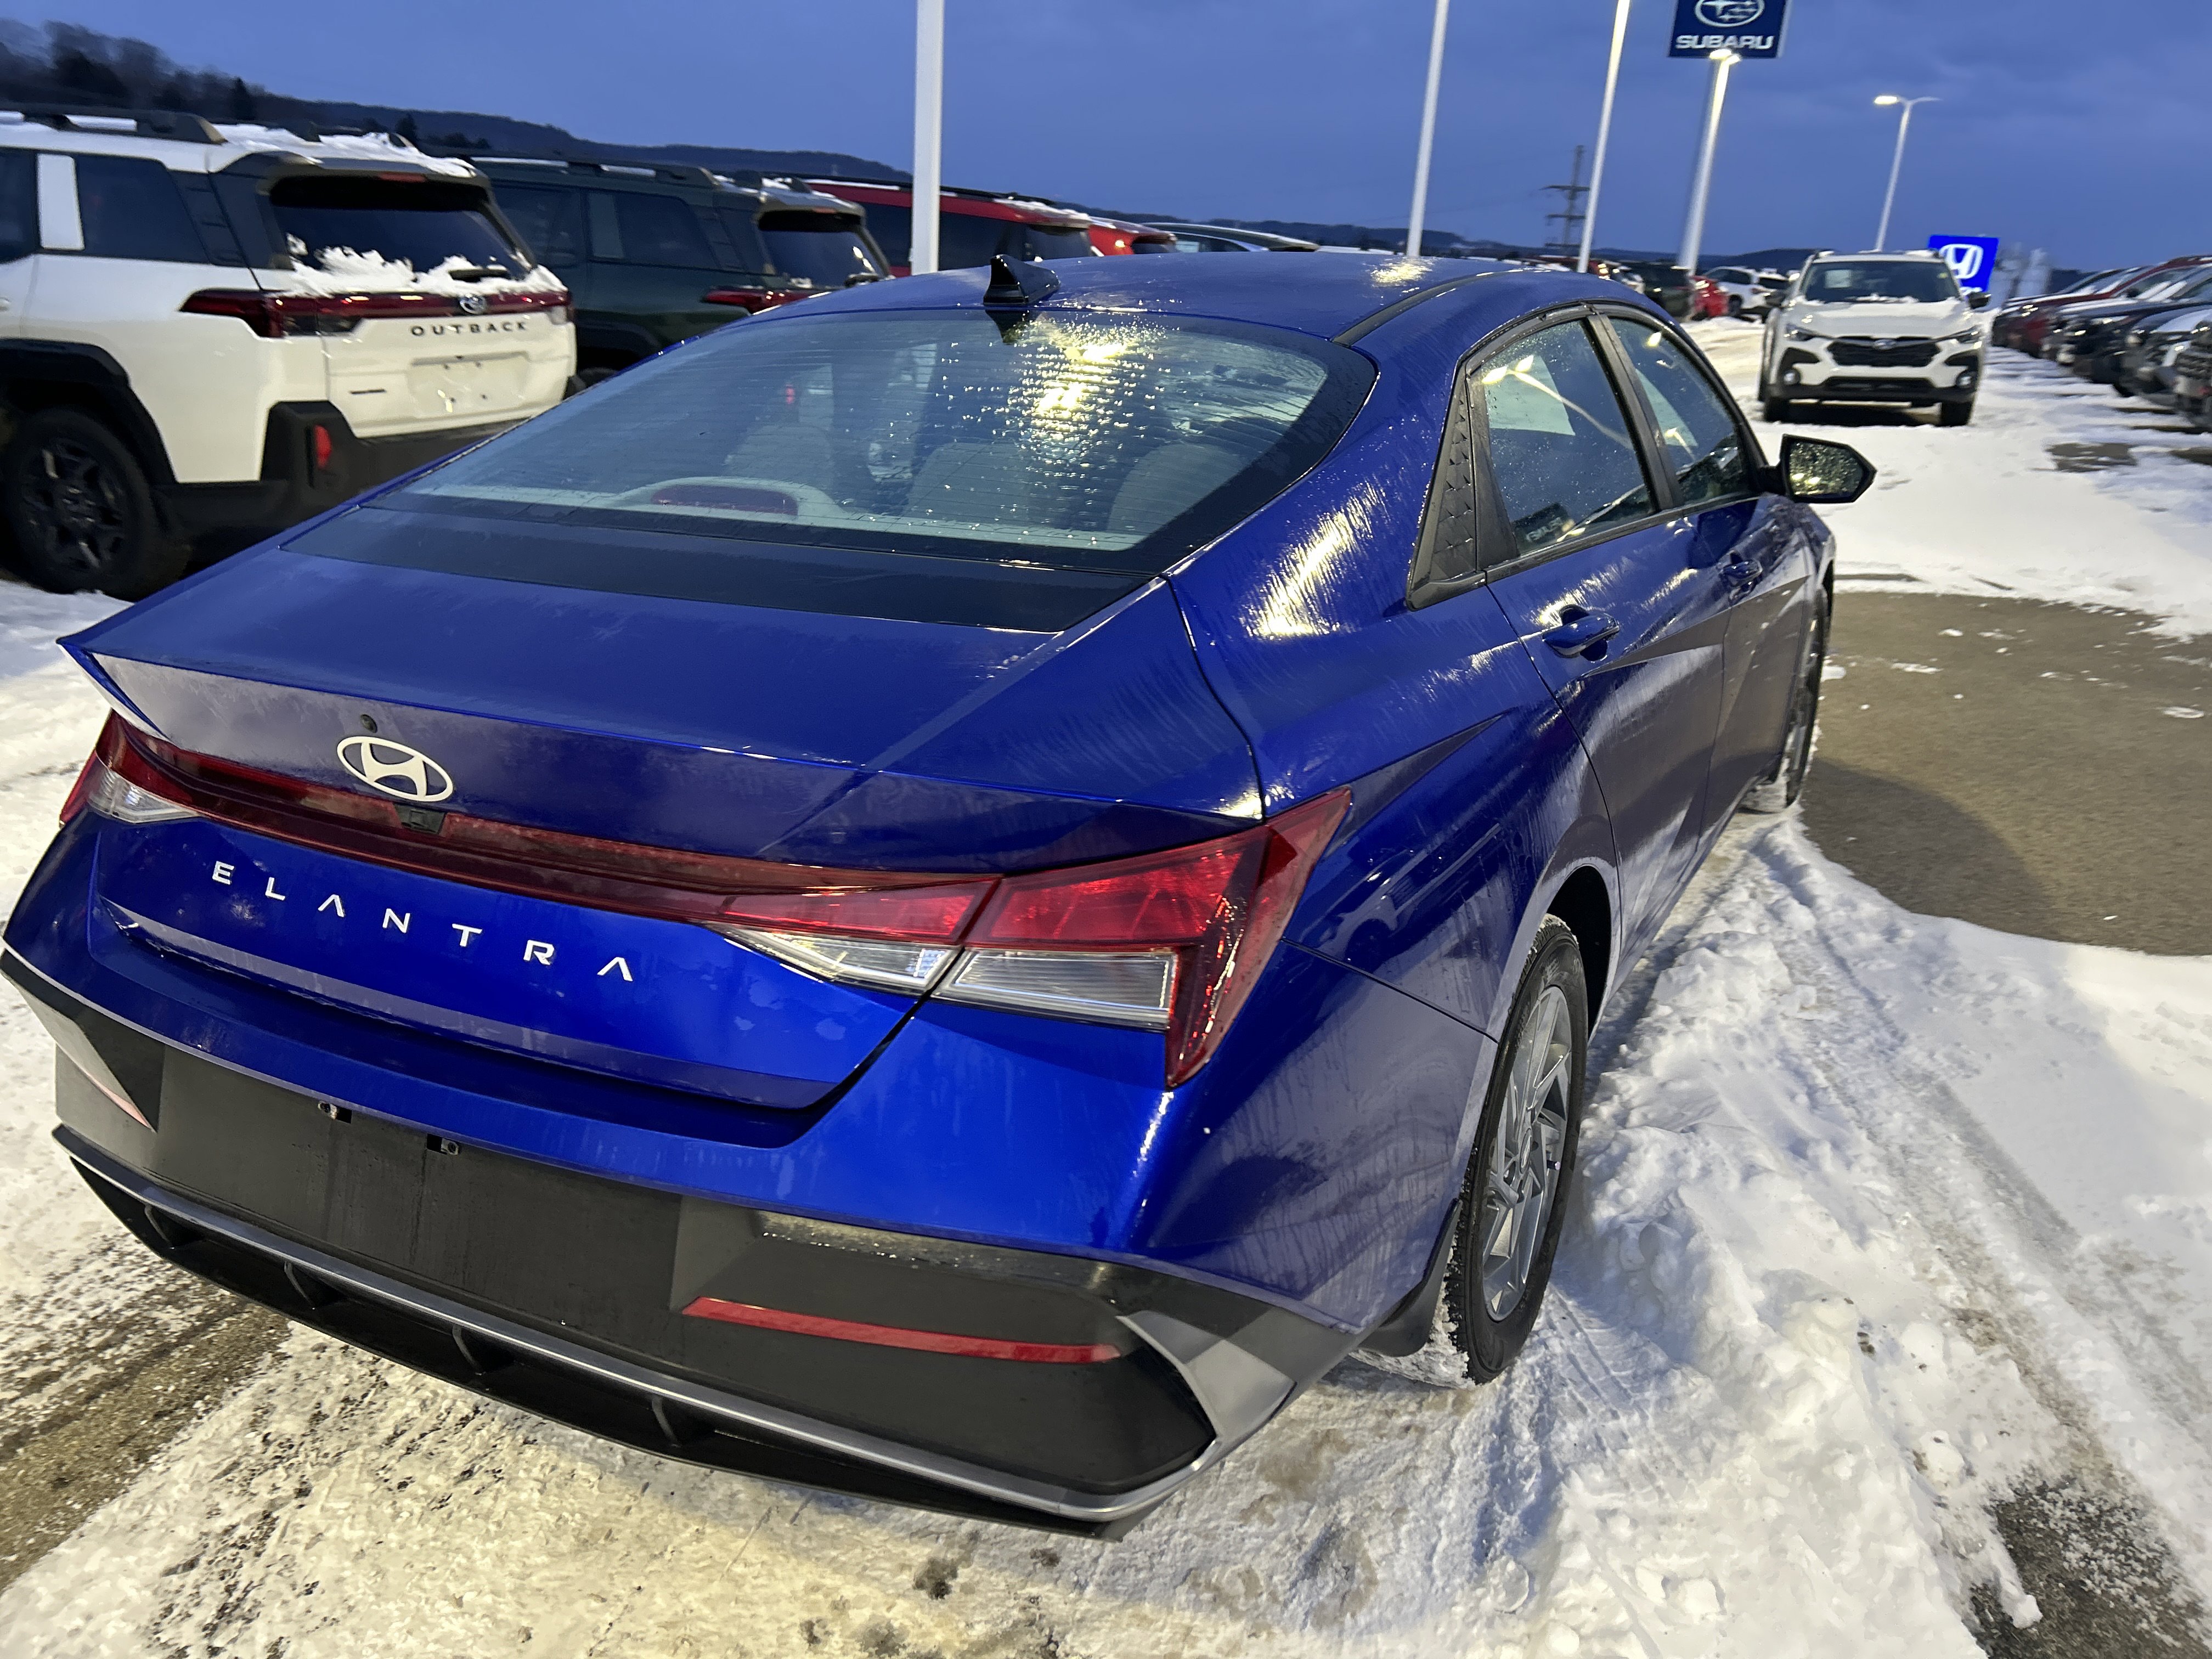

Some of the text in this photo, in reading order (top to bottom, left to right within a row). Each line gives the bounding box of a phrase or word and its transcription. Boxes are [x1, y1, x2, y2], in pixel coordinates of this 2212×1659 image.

[1675, 35, 1775, 49] SUBARU
[410, 321, 526, 336] OUTBACK
[212, 860, 633, 982] ELANTRA
